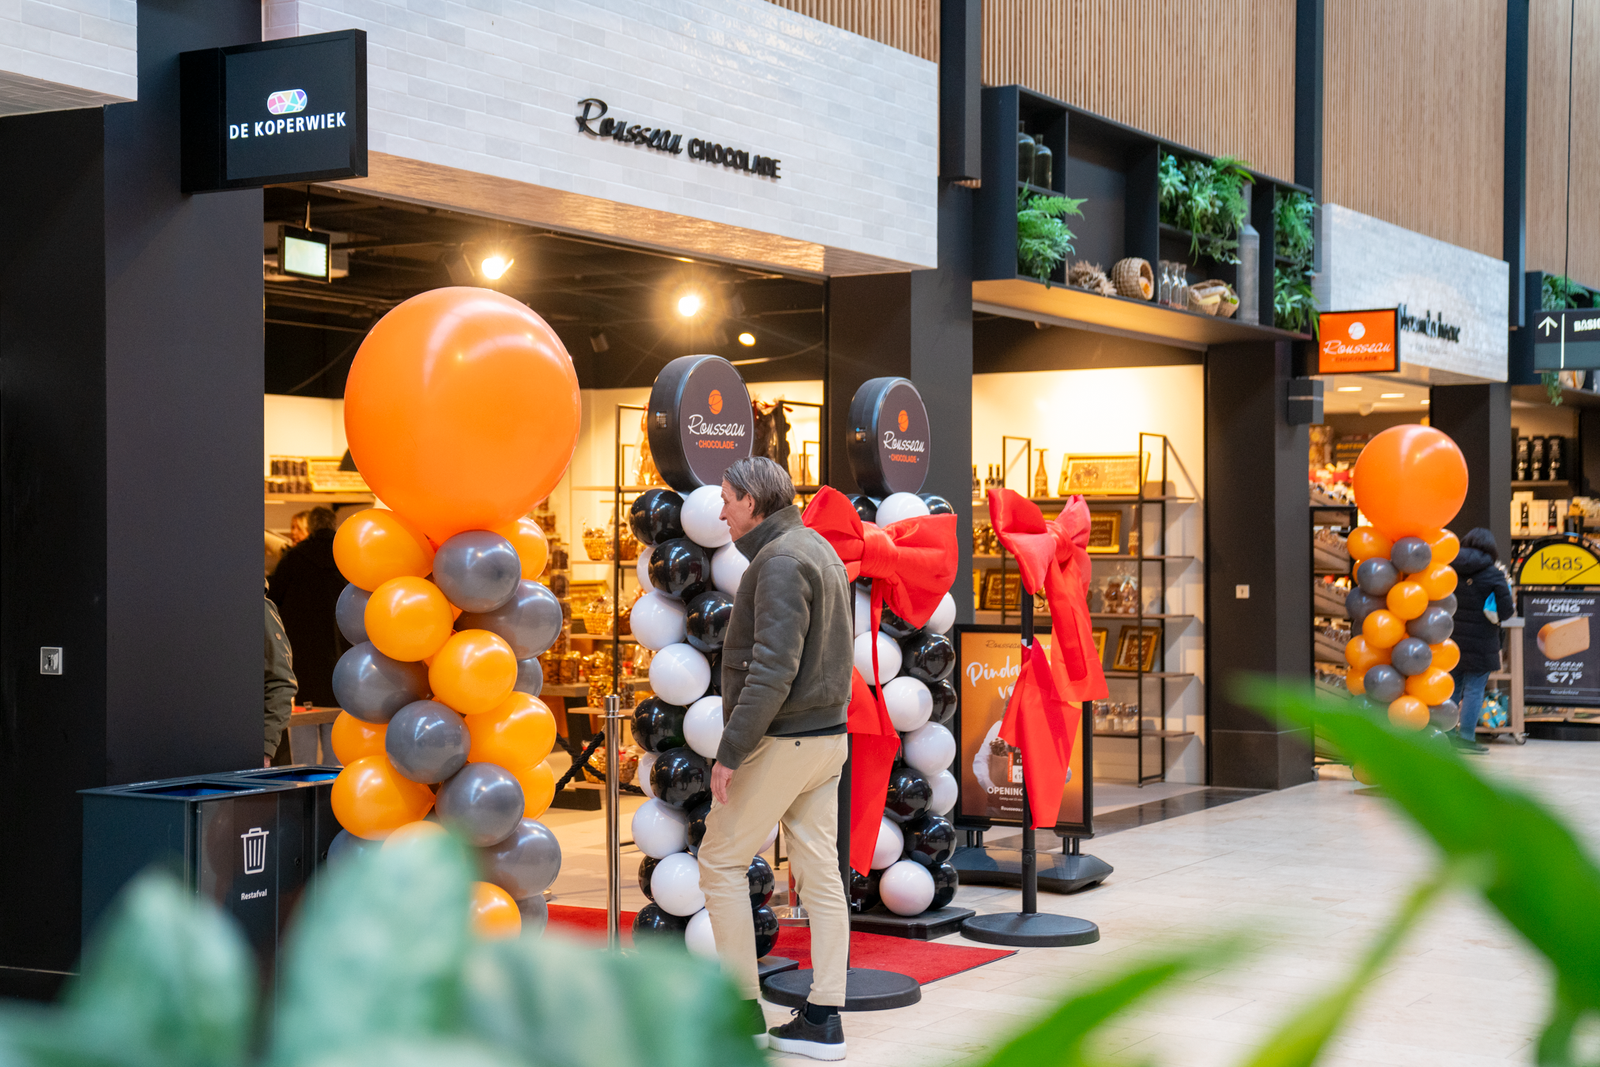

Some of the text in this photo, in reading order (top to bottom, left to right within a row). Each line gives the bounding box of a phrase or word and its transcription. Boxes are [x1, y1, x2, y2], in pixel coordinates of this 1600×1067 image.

[229, 112, 346, 139] DE KOPERWIEK
[575, 97, 782, 179] Rousseau CHOCOLADE
[1323, 339, 1392, 355] Rousseau
[1335, 355, 1378, 363] CHOCOLADE
[687, 413, 746, 438] Rousseau
[698, 439, 735, 450] CHOCOLADE
[883, 430, 926, 454] Rousseau
[890, 453, 918, 464] CHOCOLADE
[1541, 552, 1583, 571] kaas
[1546, 602, 1581, 613] JONG
[966, 655, 1021, 688] Pinda
[241, 889, 267, 900] Restafval
